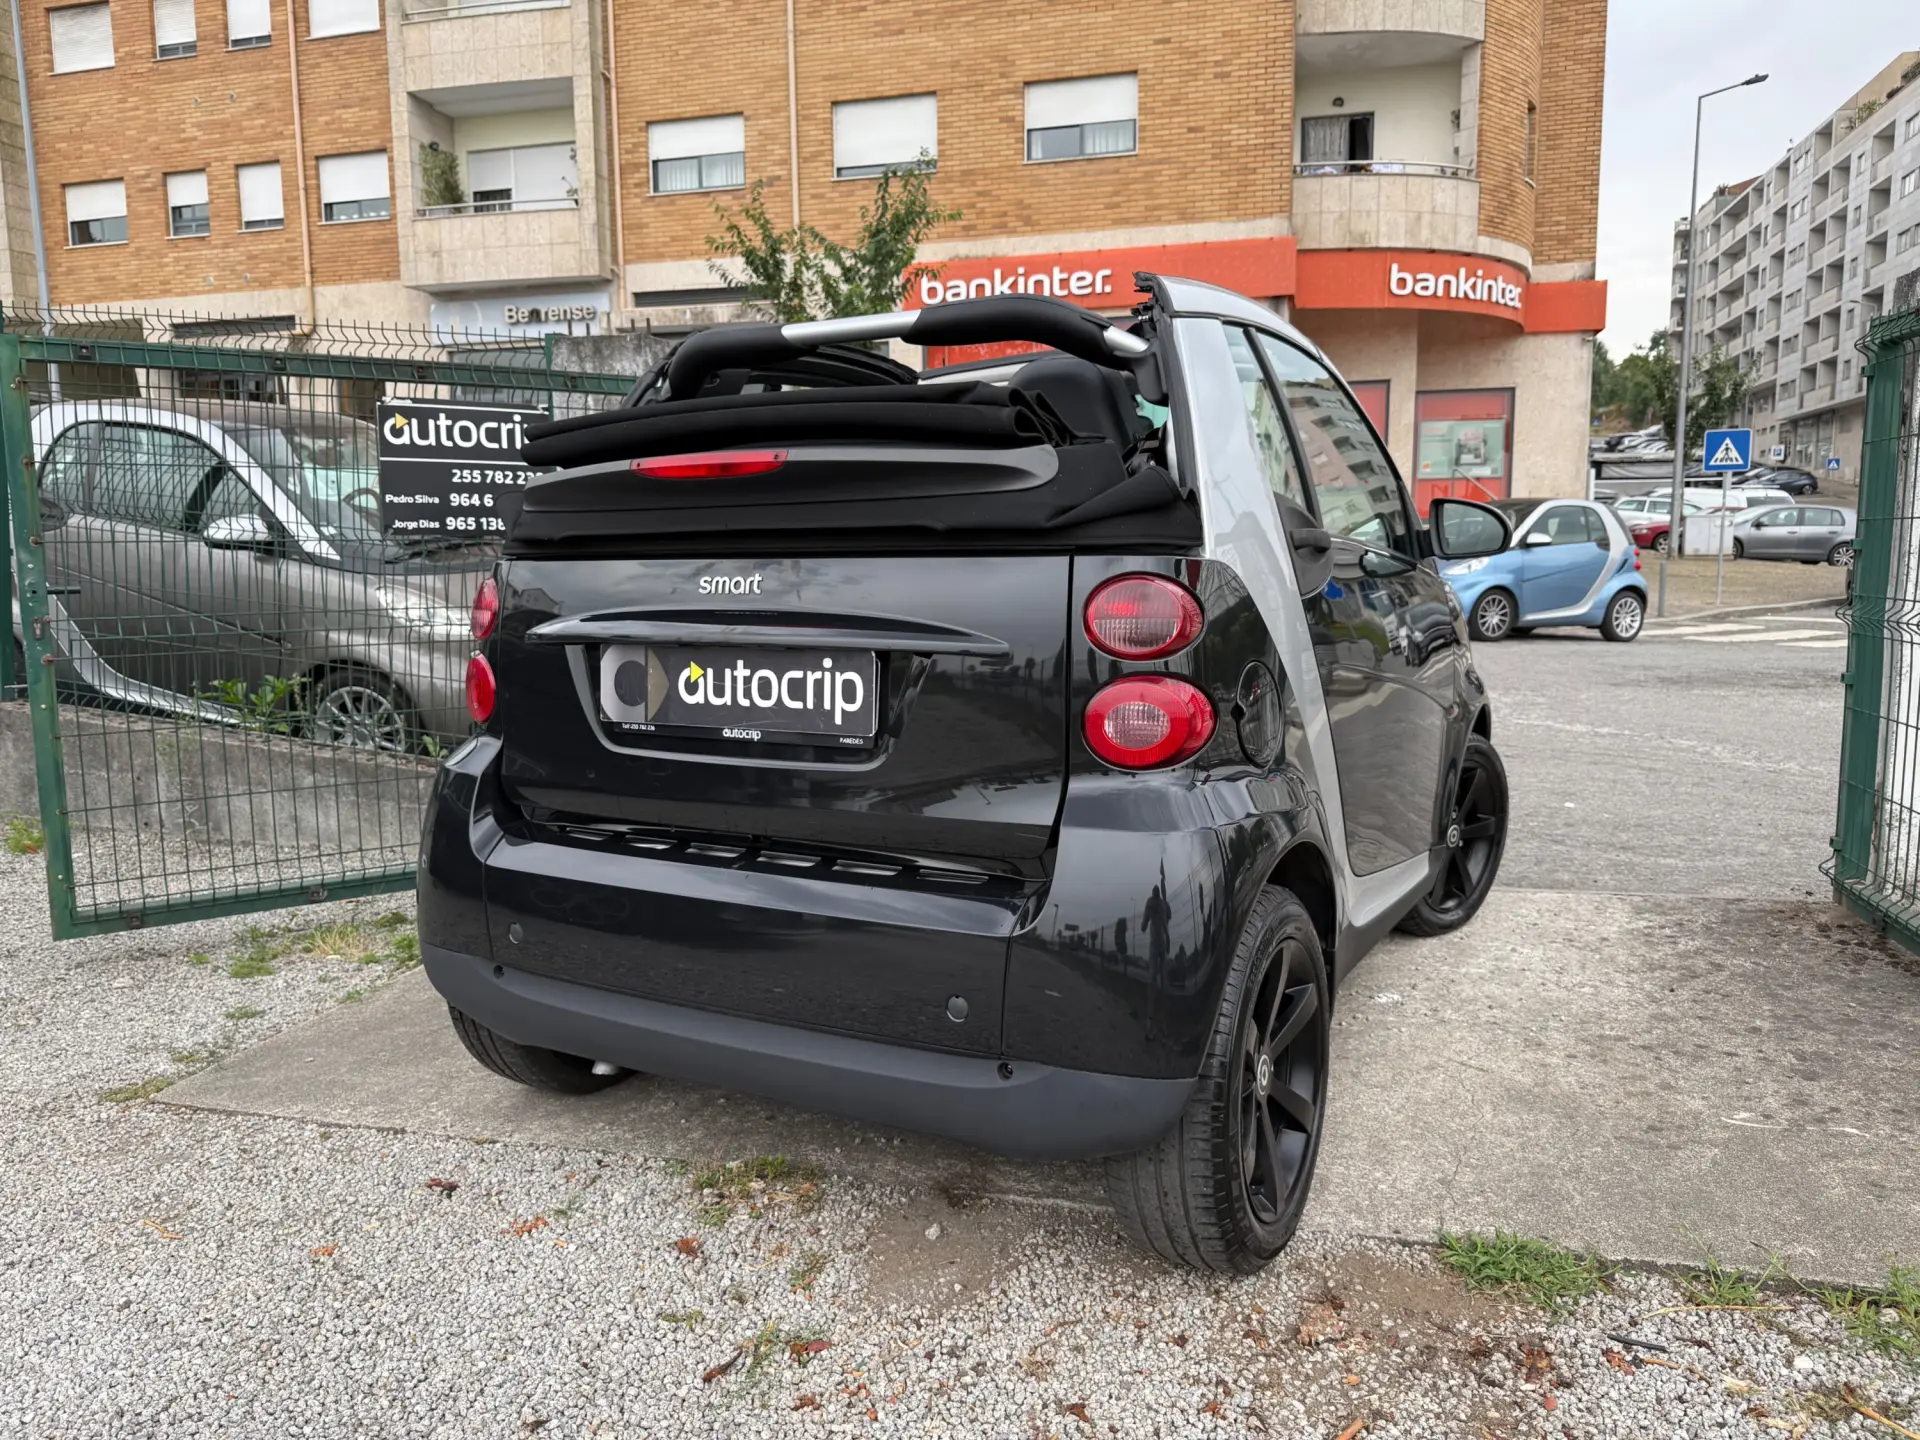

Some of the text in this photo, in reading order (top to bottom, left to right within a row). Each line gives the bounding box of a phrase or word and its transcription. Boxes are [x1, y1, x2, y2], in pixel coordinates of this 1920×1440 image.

[920, 266, 1112, 305] bankinter.
[1390, 263, 1522, 309] bankinter.
[383, 412, 530, 450] autocri
[451, 469, 482, 483] 255
[484, 470, 514, 484] 782
[385, 494, 414, 504] Pedro
[414, 494, 440, 504] Silva
[449, 493, 481, 507] 964
[392, 519, 418, 530] Jorge
[418, 519, 440, 529] Dias
[445, 516, 476, 531] 965
[699, 573, 763, 595] smart
[678, 657, 864, 725] autocrip
[722, 728, 762, 742] autocrip
[839, 737, 864, 745] PAREDES
